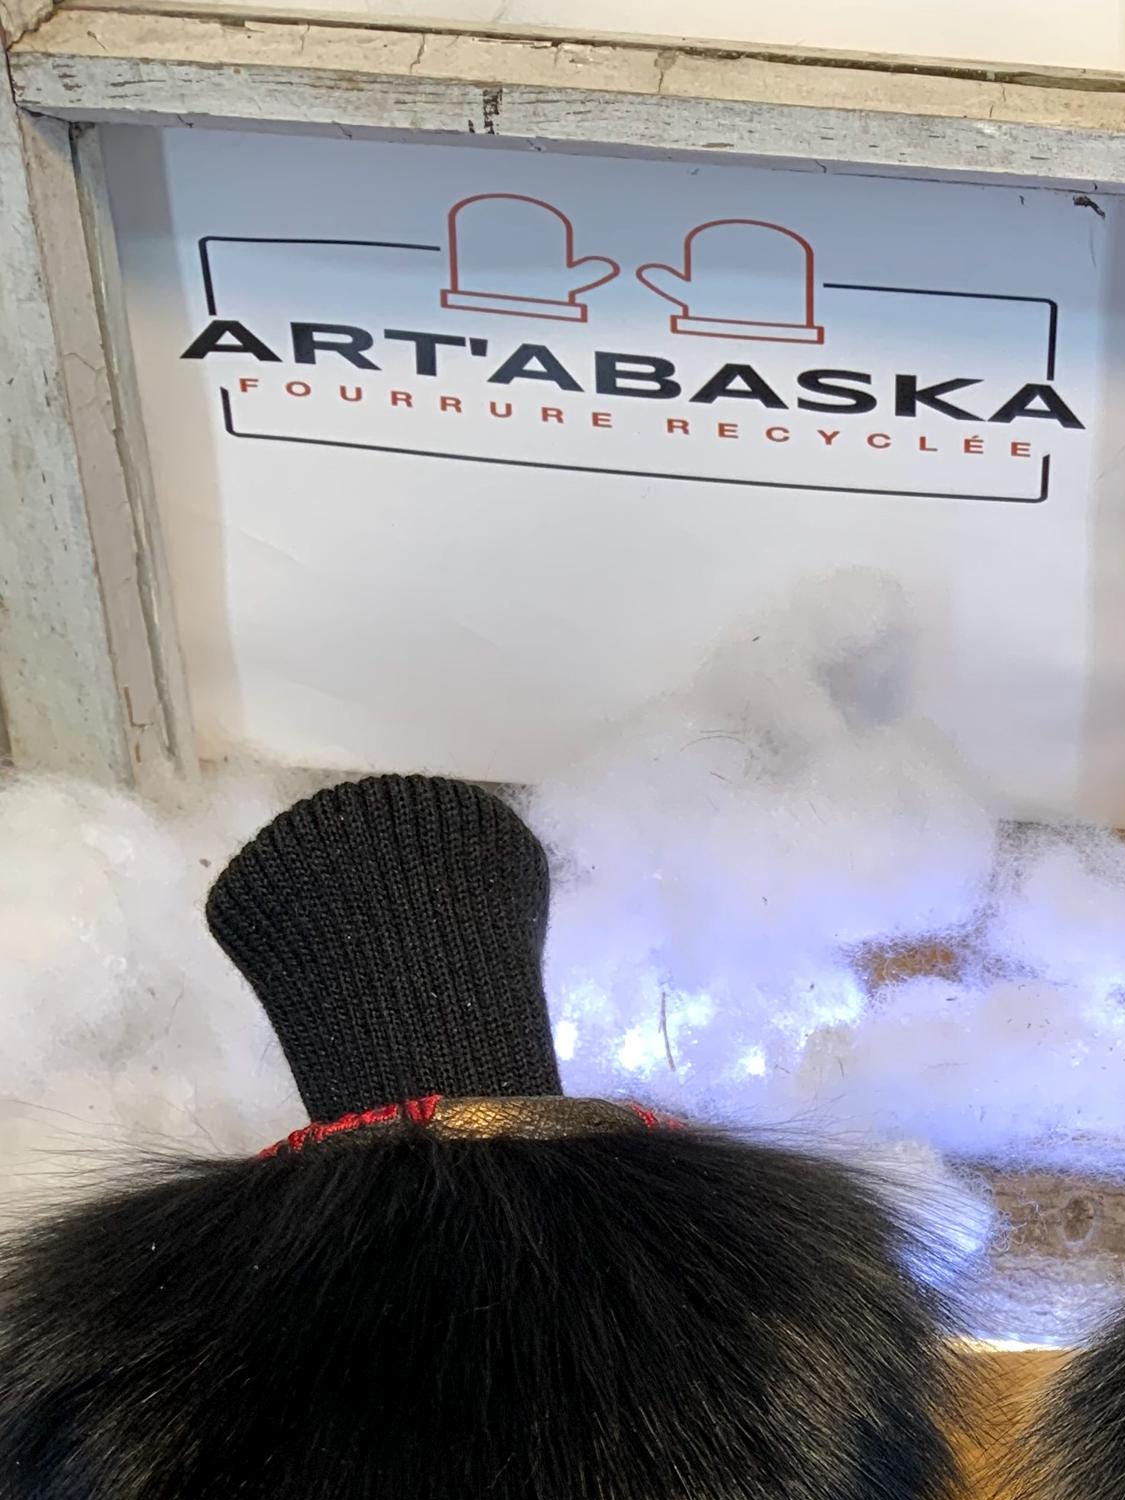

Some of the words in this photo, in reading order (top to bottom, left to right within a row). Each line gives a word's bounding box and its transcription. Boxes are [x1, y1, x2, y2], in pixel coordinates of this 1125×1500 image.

[180, 318, 1086, 430] ART'ABASKA
[238, 377, 614, 430] FOURRURE
[665, 417, 1033, 460] RECYCLÉE
